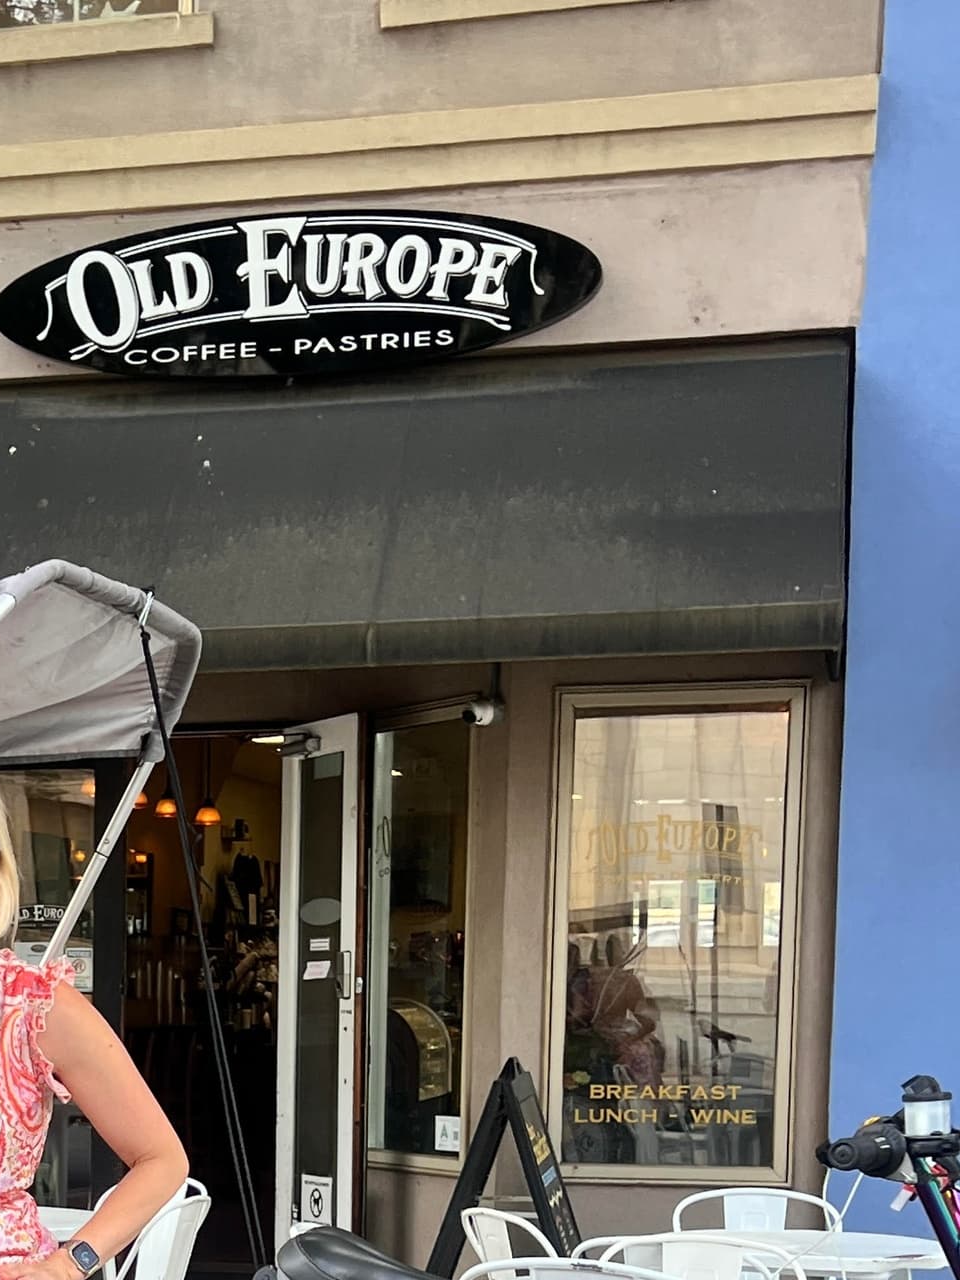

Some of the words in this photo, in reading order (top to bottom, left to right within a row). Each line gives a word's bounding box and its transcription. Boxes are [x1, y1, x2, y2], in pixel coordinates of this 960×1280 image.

[65, 249, 213, 349] OLD
[236, 217, 522, 321] EUROPE
[124, 341, 256, 365] COFFEE
[294, 329, 454, 356] PASTRIES
[33, 904, 64, 922] EURO
[590, 1084, 742, 1101] BREAKFAST
[574, 1108, 657, 1124] LUNCH
[690, 1108, 758, 1125] WINE
